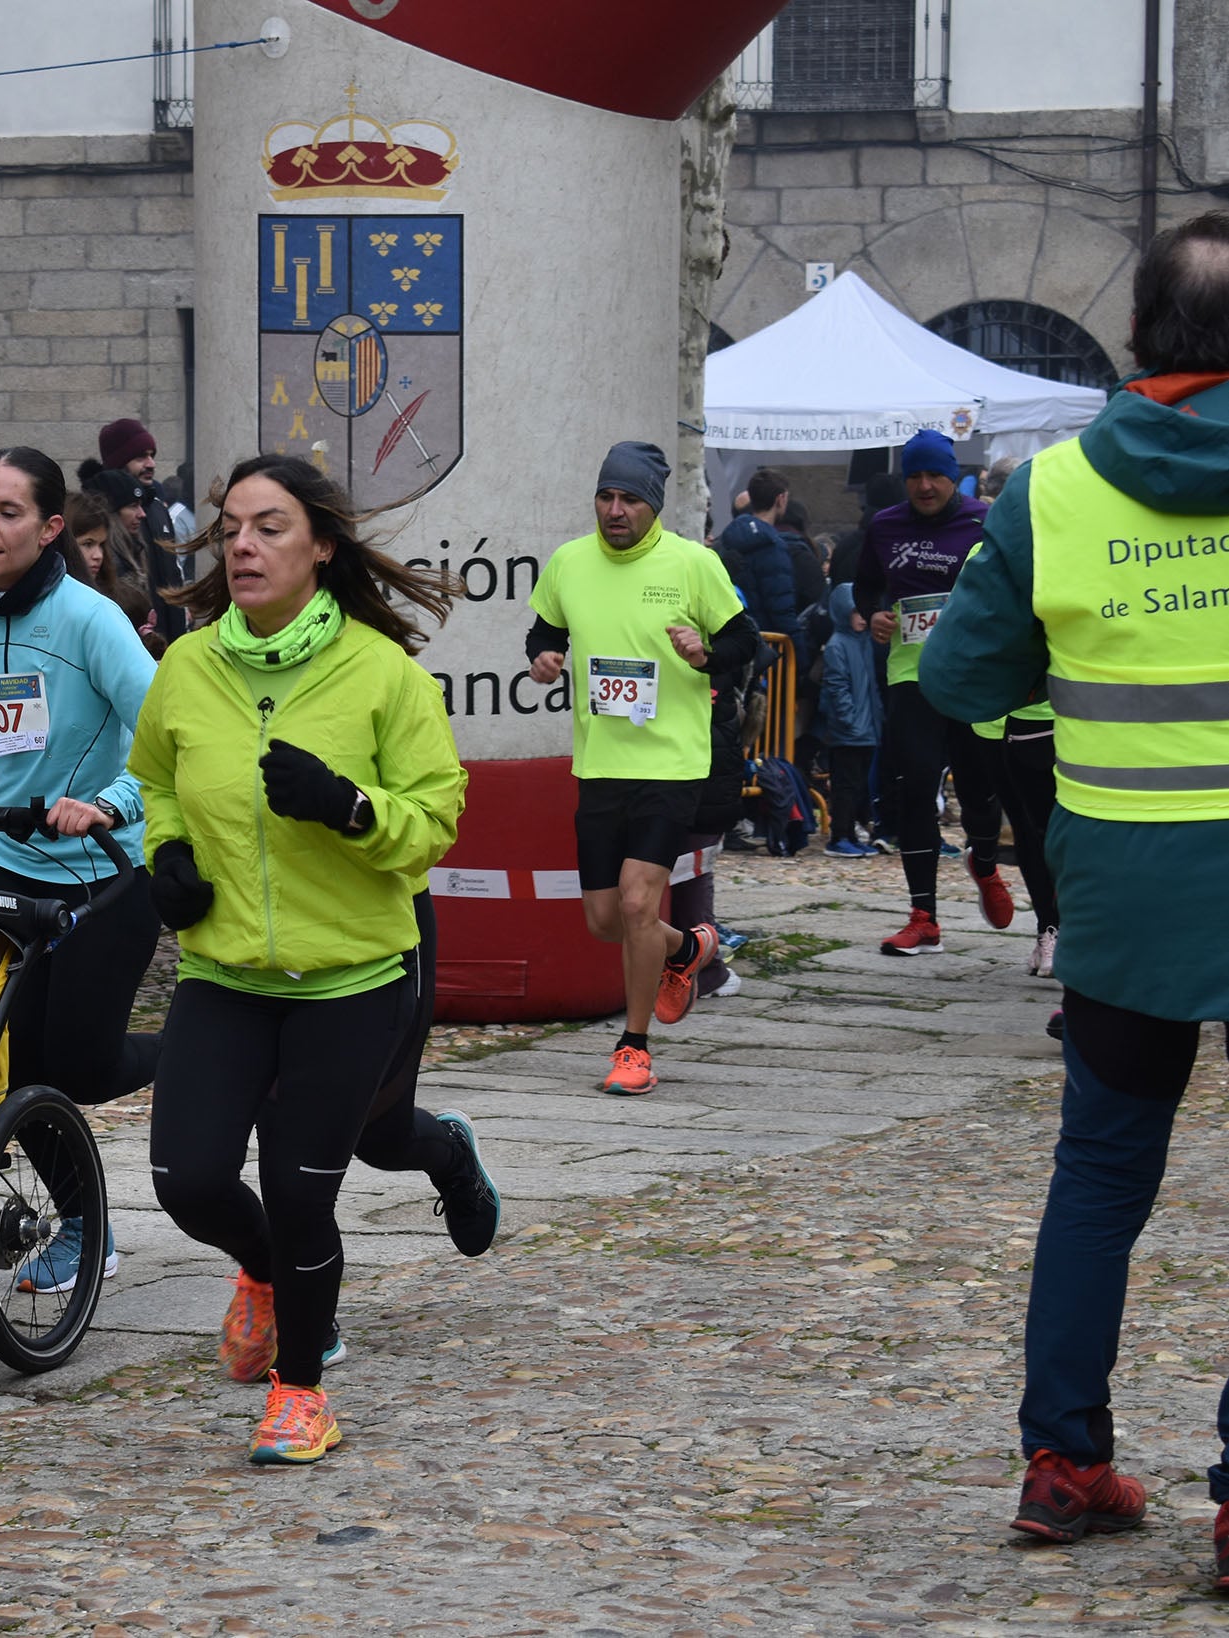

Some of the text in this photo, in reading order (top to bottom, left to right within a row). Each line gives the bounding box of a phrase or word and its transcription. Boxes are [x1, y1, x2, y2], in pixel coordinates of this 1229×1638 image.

[812, 264, 827, 289] 5
[734, 427, 749, 439] DE
[821, 428, 836, 440] DE
[838, 425, 872, 440] ALBA
[875, 425, 890, 438] DE
[918, 551, 958, 565] Abadengo
[916, 561, 949, 574] Running
[1101, 598, 1130, 619] de
[0, 677, 29, 685] NAVIDAD
[598, 677, 638, 703] 393
[34, 736, 45, 744] 607
